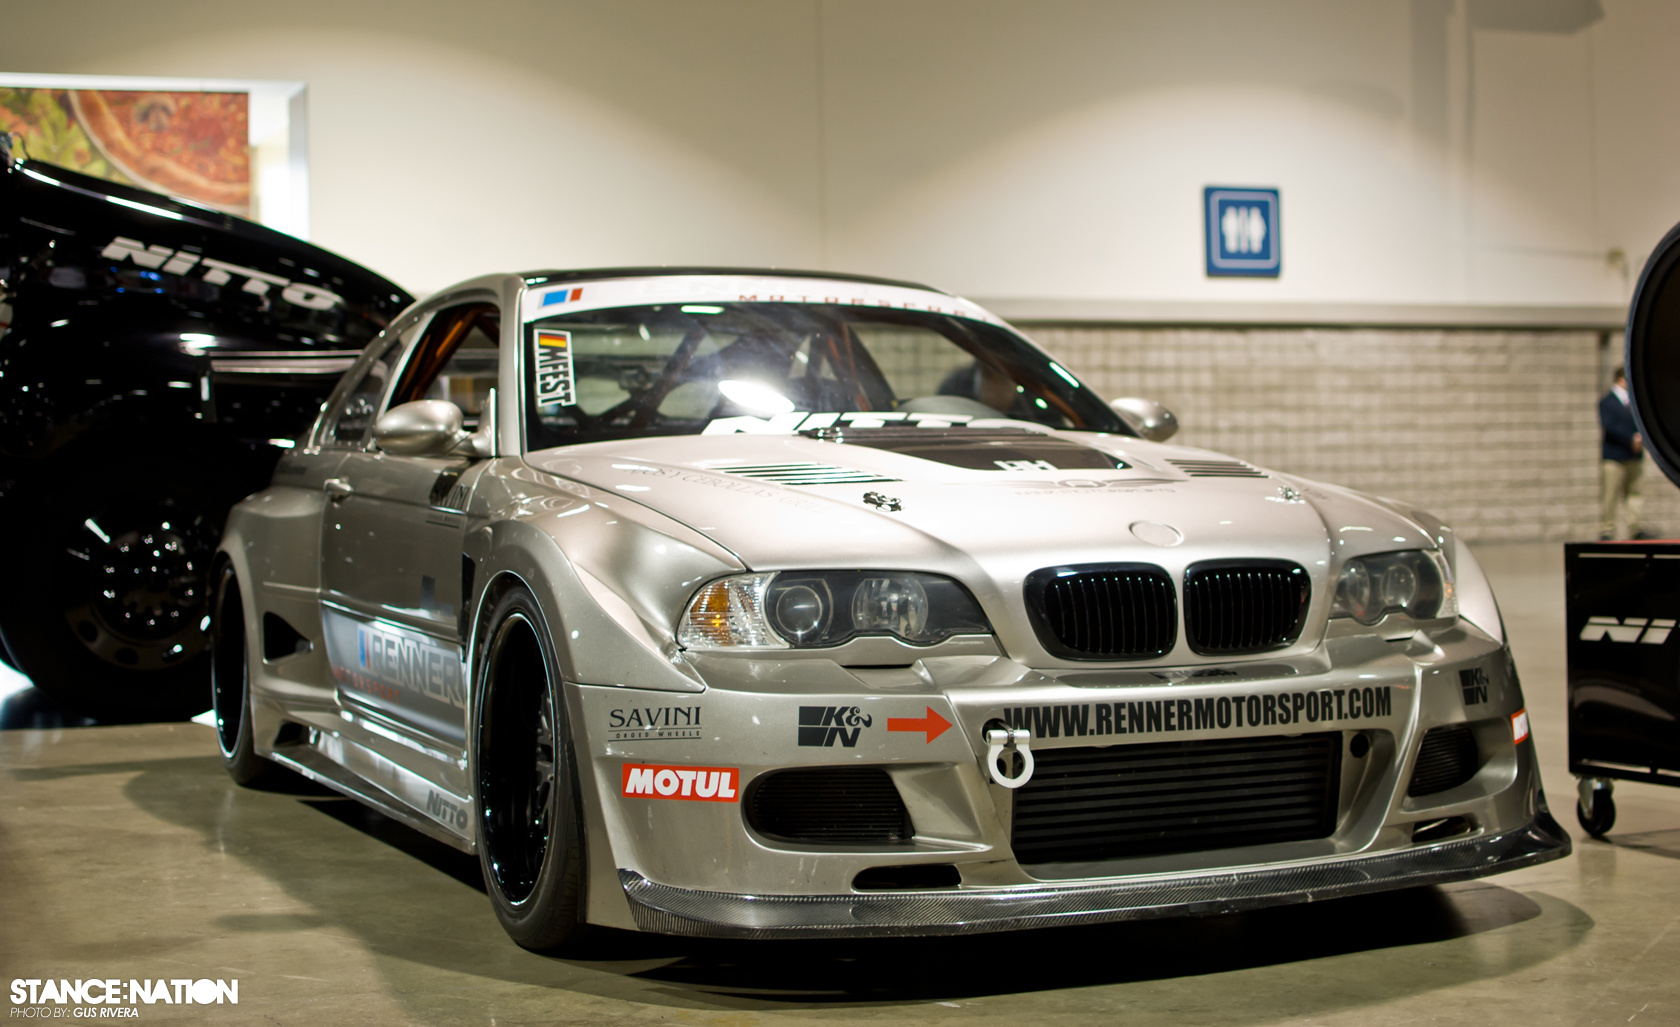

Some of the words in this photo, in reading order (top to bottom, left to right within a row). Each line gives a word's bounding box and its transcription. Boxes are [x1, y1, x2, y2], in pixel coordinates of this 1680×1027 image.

[101, 236, 345, 311] NITTO
[537, 345, 574, 405] MFEST
[371, 630, 467, 709] RENNER
[609, 706, 702, 728] SAVINI
[658, 730, 700, 738] WHEELS
[1003, 686, 1392, 738] WWW.RENNERMOTORSPORT.COM
[625, 768, 736, 798] MOTUL
[426, 789, 469, 830] NITTO
